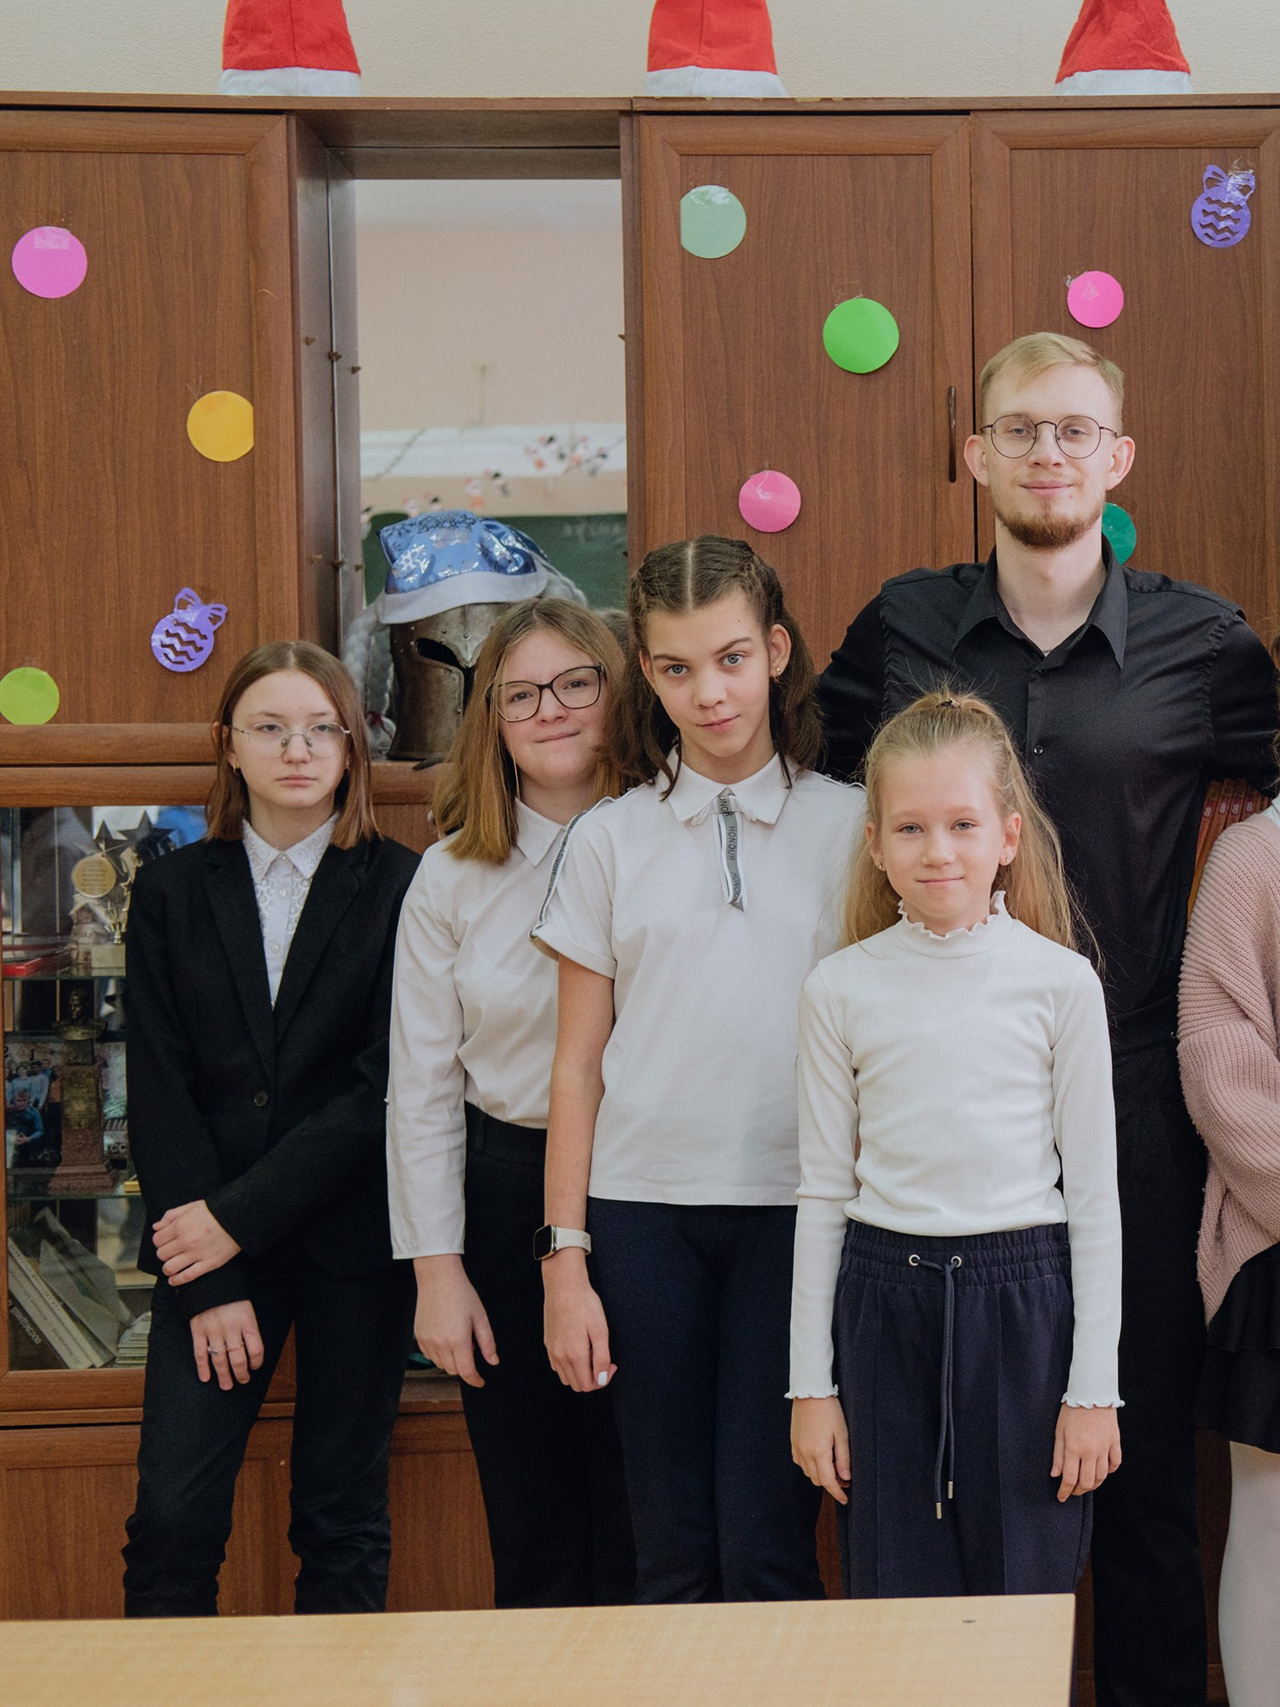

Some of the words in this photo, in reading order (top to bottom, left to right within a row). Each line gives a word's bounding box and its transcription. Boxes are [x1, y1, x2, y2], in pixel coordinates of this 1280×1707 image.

[1204, 807, 1211, 817] 8
[1219, 803, 1227, 813] 8
[1232, 804, 1239, 814] 8
[1246, 802, 1253, 812] 8
[728, 826, 737, 861] HONOUR
[732, 872, 741, 903] HONOU
